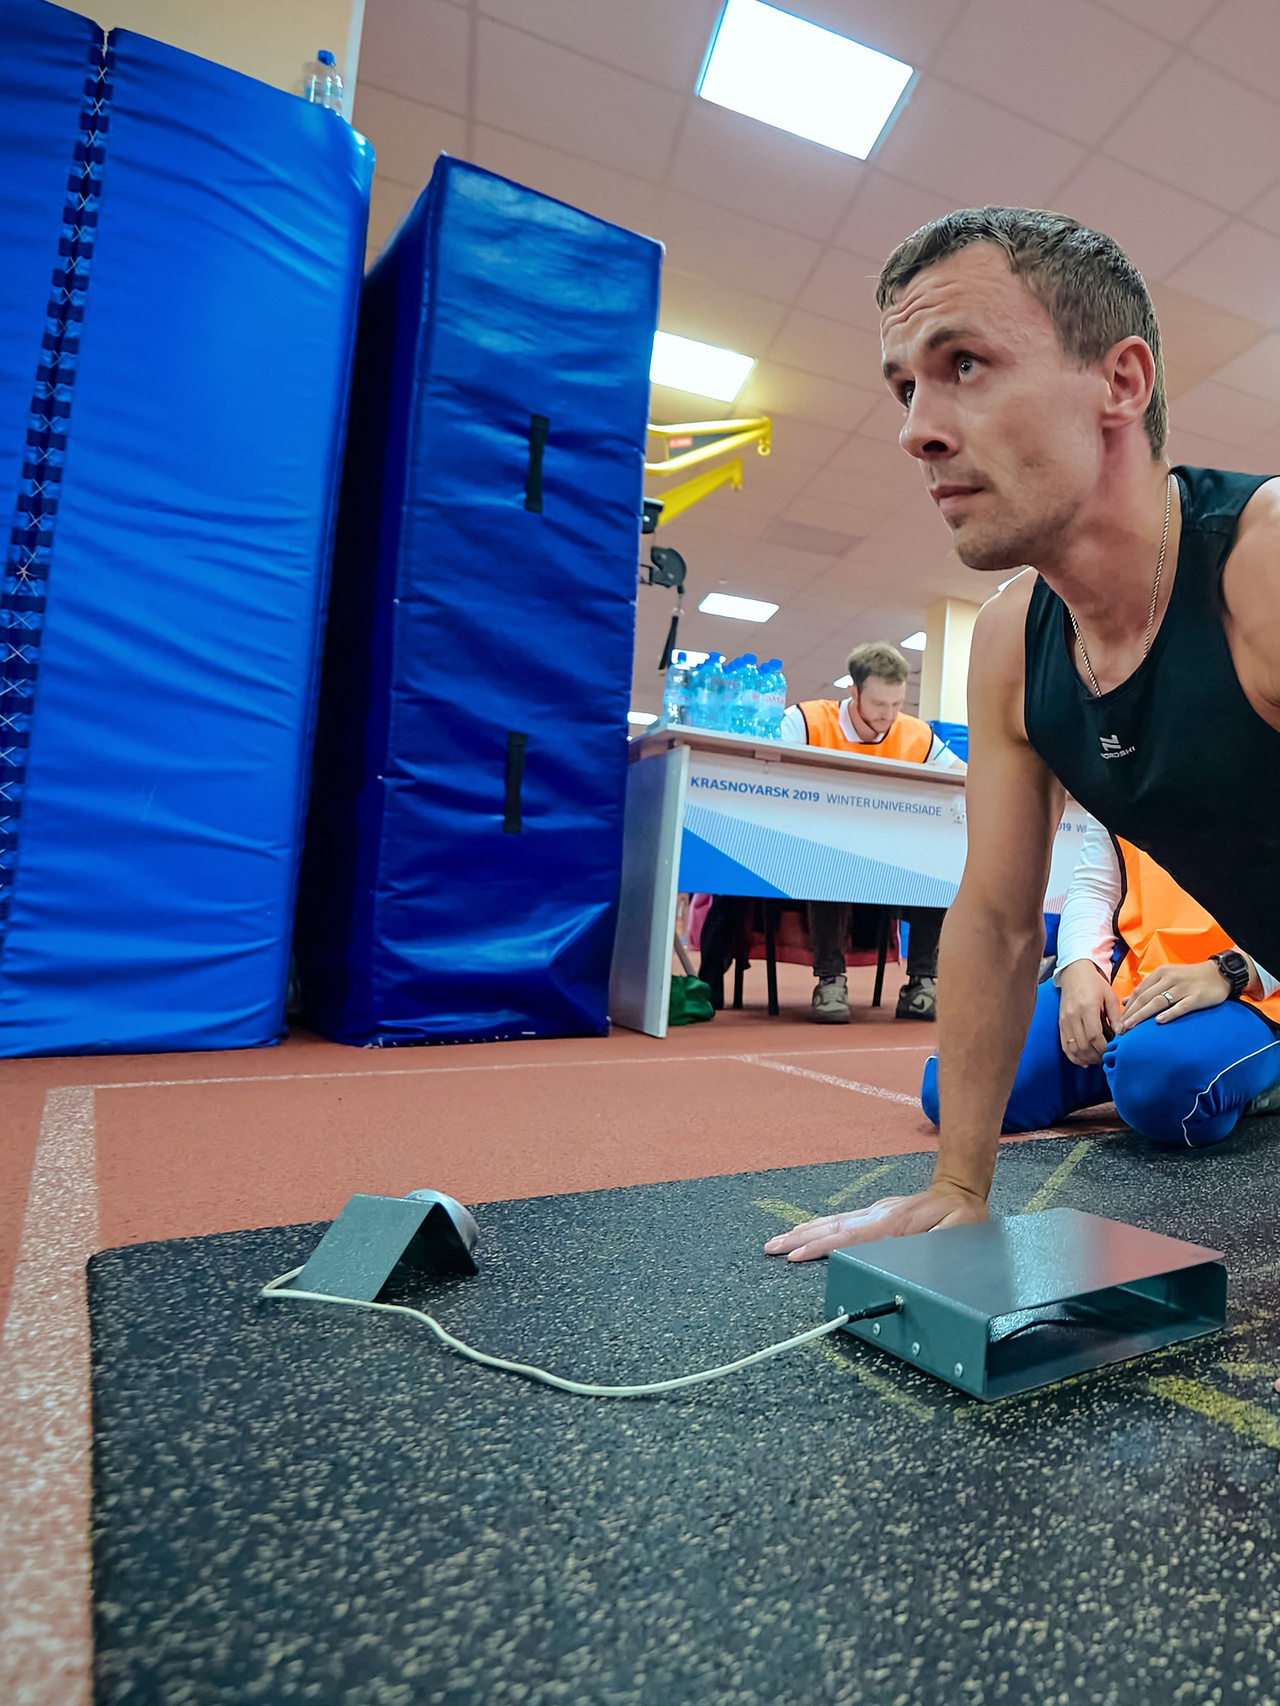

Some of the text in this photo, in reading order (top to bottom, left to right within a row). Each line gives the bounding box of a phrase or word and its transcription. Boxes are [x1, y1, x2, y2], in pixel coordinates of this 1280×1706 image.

[690, 776, 942, 817] KRASNOYARSK 2019 WINTER UNIVERSIADE
